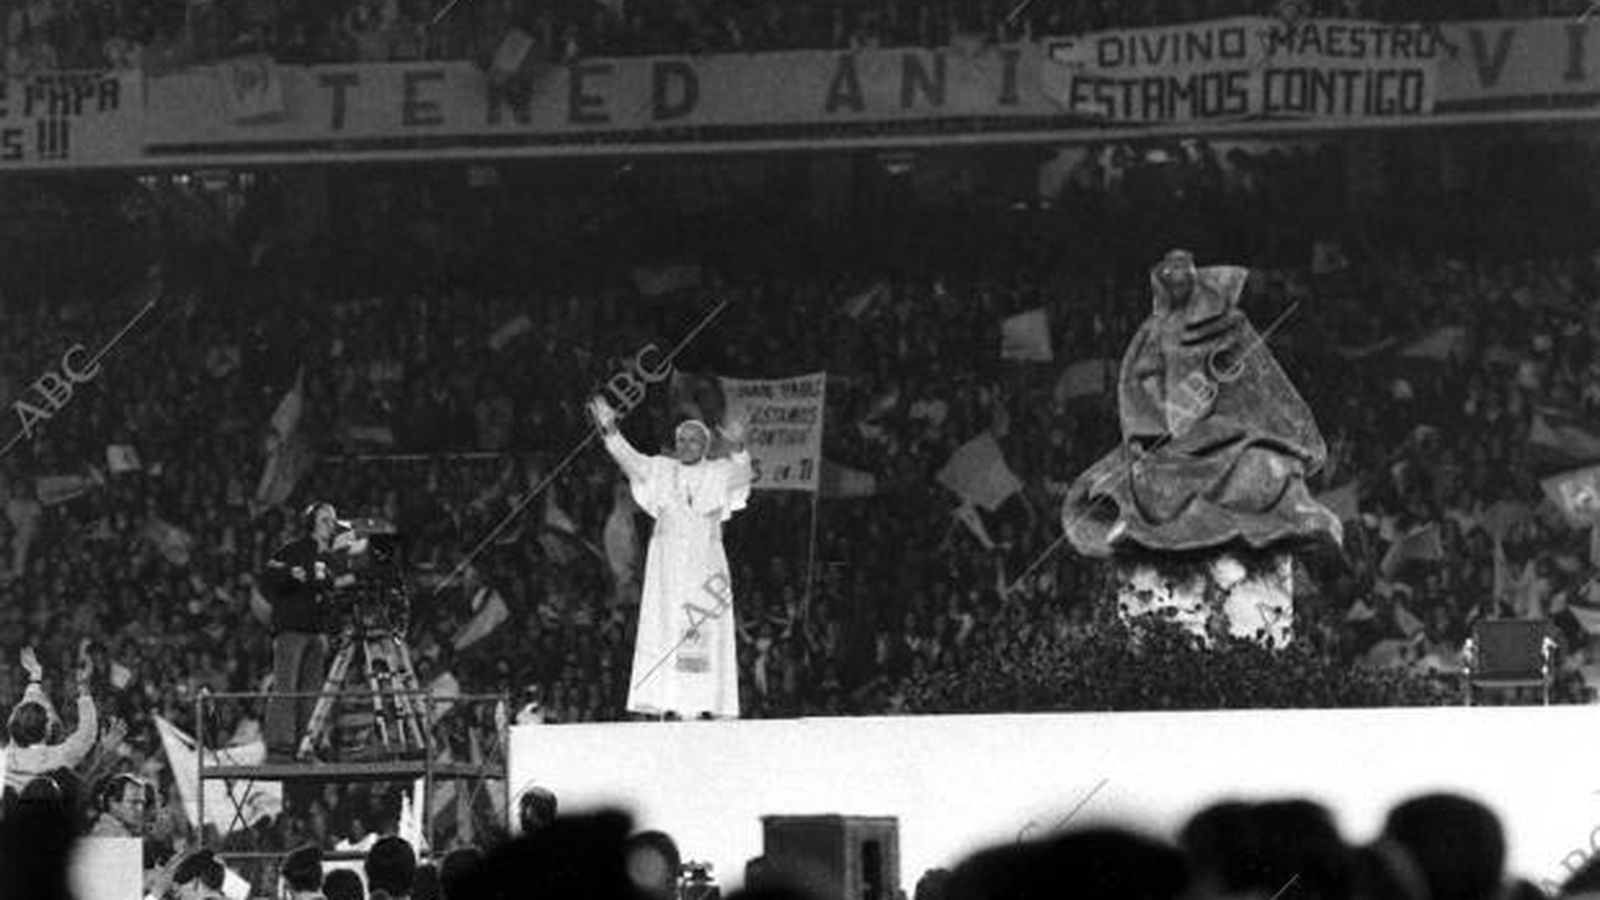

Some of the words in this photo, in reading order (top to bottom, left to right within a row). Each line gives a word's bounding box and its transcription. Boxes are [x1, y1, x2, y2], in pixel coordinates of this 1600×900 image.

[1098, 27, 1246, 67] DIVINO
[1268, 23, 1436, 59] MAESTRO
[1070, 71, 1250, 120] ESTAMOS
[1263, 68, 1424, 115] CONTIGO
